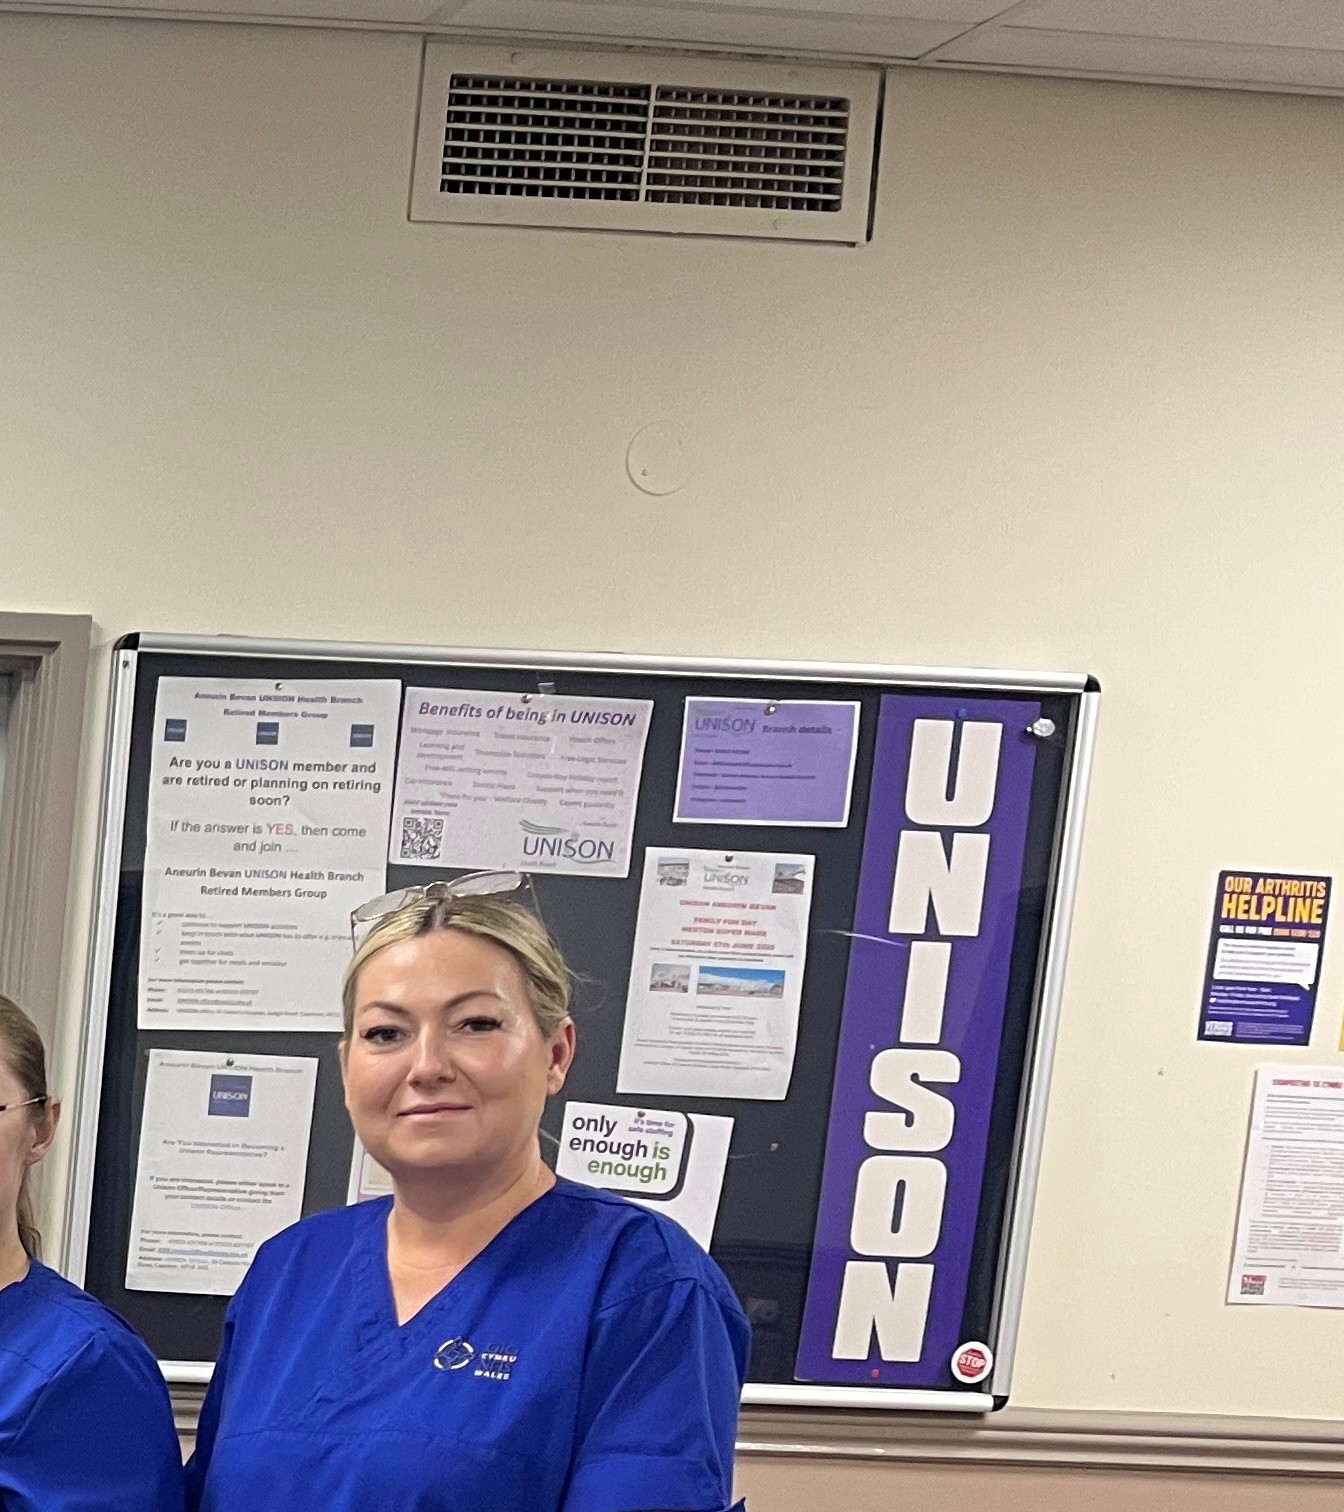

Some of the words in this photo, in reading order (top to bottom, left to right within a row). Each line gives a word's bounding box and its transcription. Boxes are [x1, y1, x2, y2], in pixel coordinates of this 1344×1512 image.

[419, 702, 482, 718] Benefits
[486, 705, 503, 719] of
[506, 707, 547, 725] being
[552, 710, 565, 723] in
[571, 711, 636, 726] UNISON
[695, 717, 756, 732] UNISON
[169, 756, 192, 769] Are
[196, 759, 220, 771] you
[236, 759, 288, 771] UNISON
[293, 762, 348, 773] member
[351, 762, 376, 773] and
[162, 777, 182, 785] are
[187, 775, 229, 787] retired
[234, 779, 247, 787] or
[251, 778, 307, 792] planning
[312, 781, 328, 790] on
[333, 780, 381, 793] retiring
[249, 795, 290, 806] soon?
[522, 836, 614, 860] UNISON
[165, 867, 206, 878] Aneurin
[209, 868, 241, 879] Bevan
[245, 870, 287, 880] UNISON
[290, 870, 324, 880] Health
[328, 872, 364, 882] Branch
[201, 886, 238, 896] Retired
[242, 887, 291, 898] Members
[295, 888, 327, 899] Group
[1225, 876, 1252, 893] OUR
[1255, 878, 1326, 897] ARTHRITIS
[1221, 893, 1324, 924] HELPLINE
[831, 718, 1003, 1362] UNISON
[572, 1115, 617, 1137] only
[569, 1137, 647, 1161] enough
[652, 1141, 670, 1160] is
[588, 1159, 667, 1184] enough
